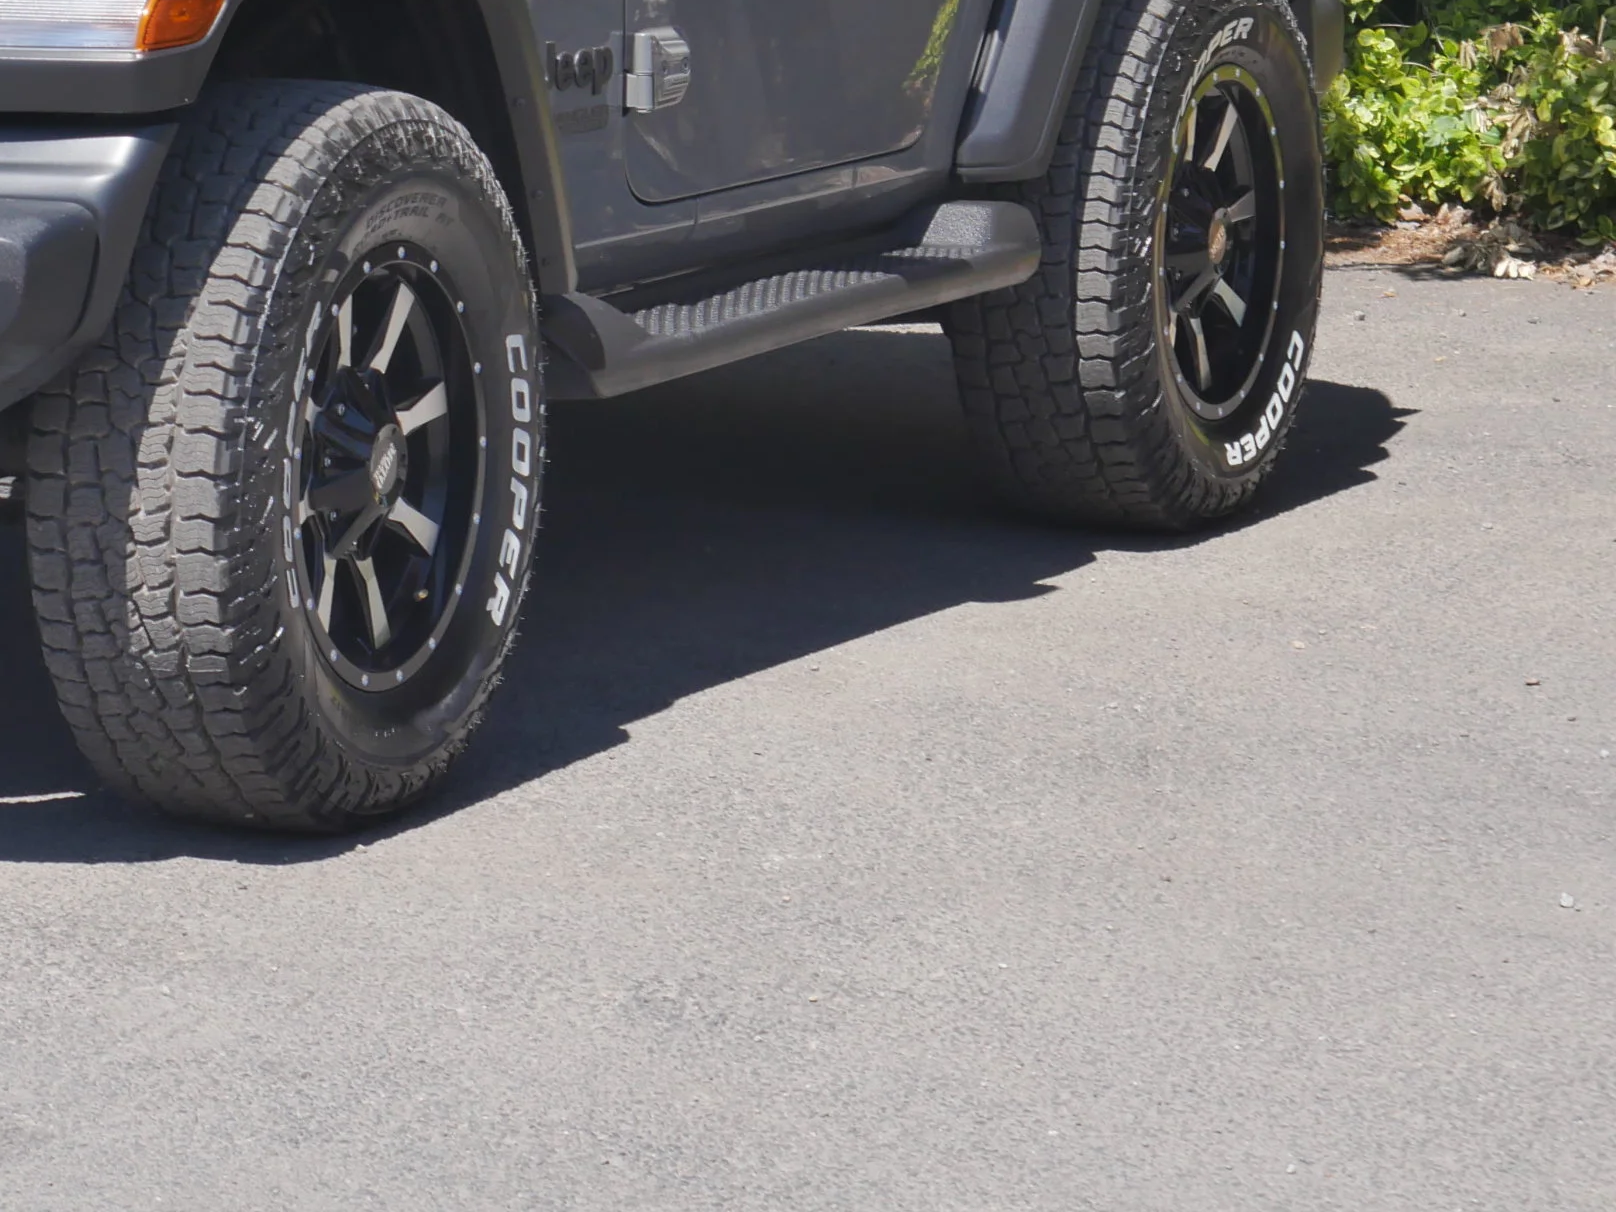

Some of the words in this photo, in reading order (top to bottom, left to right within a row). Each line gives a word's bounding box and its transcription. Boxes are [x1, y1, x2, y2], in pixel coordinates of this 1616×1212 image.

[544, 40, 614, 96] Jeep
[1224, 330, 1304, 466] COOPER
[486, 333, 532, 626] COOPER
